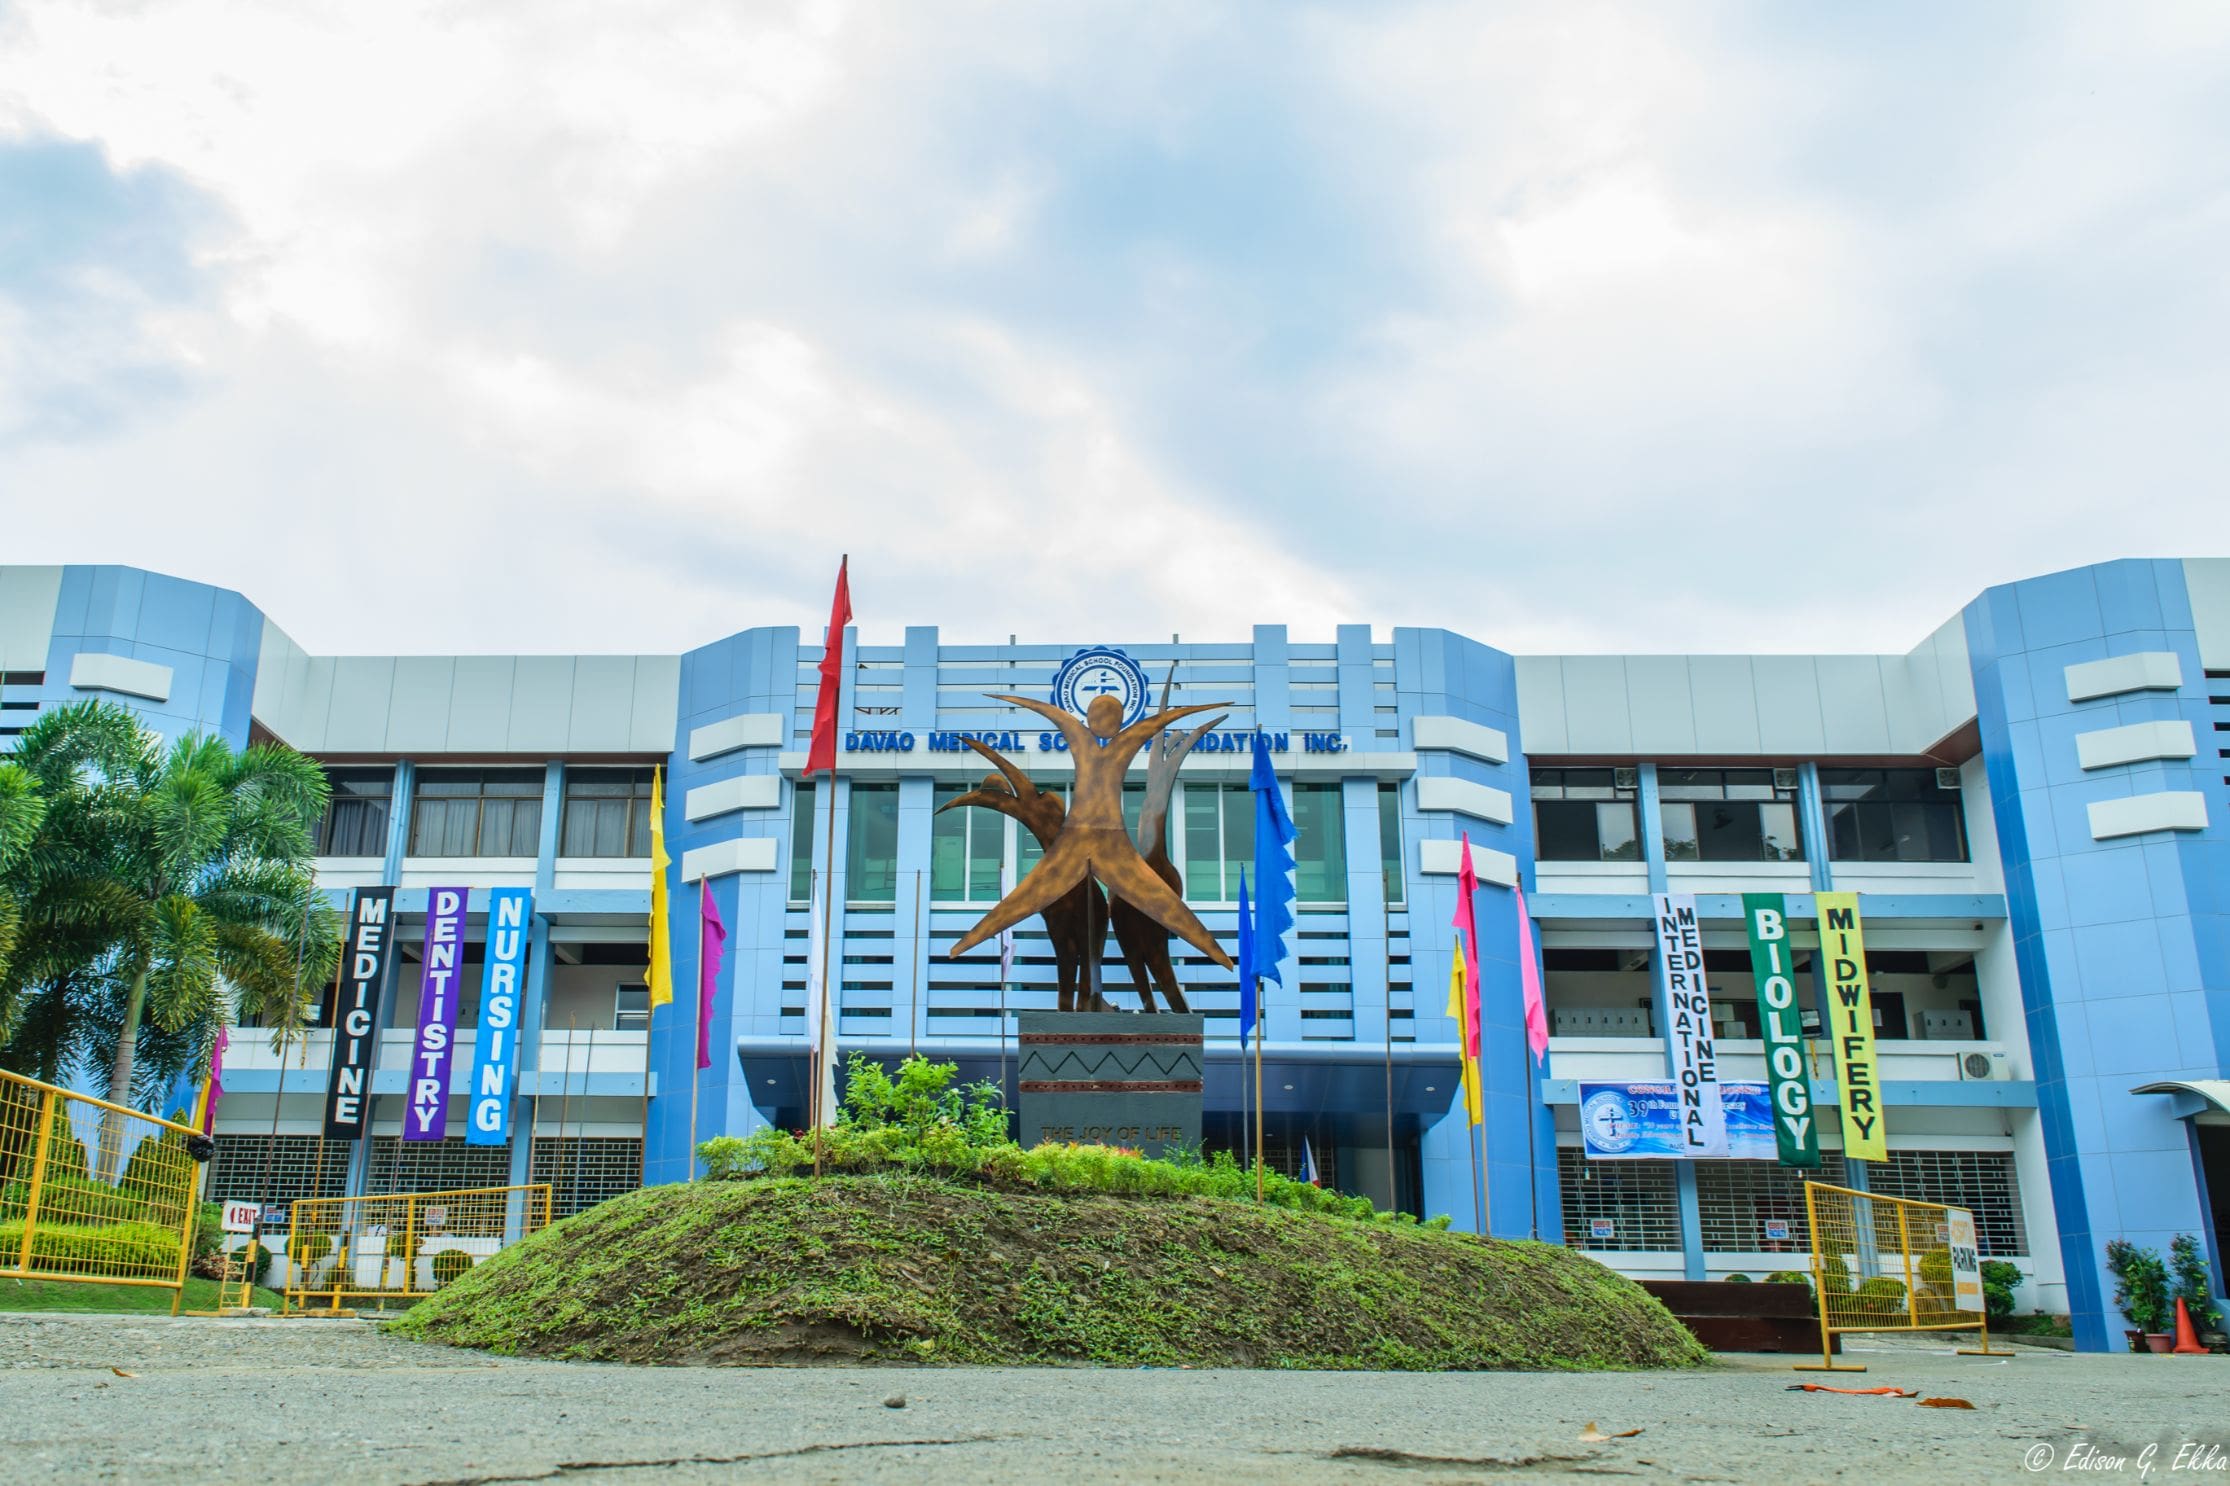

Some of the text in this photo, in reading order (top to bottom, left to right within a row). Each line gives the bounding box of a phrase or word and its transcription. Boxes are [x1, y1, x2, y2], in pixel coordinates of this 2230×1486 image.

[845, 732, 915, 752] DAVAO
[1144, 732, 1290, 753] NDATION
[1063, 664, 1084, 690] MEDICAL
[1084, 657, 1112, 667] SCHOOL
[1114, 659, 1138, 698] FOUNDATION
[334, 898, 387, 1124] MEDICINE
[415, 891, 460, 1132] DENTISTRY
[476, 897, 523, 1132] NURSING
[1662, 897, 1705, 1147] INTERNATIONAL
[1677, 907, 1716, 1083] MEDICINE
[1754, 908, 1810, 1150] BIOLOGY
[1826, 908, 1876, 1141] MIDWIFERY
[238, 1207, 257, 1225] EXIT
[1041, 1126, 1182, 1141] THE JOY OF LIFE
